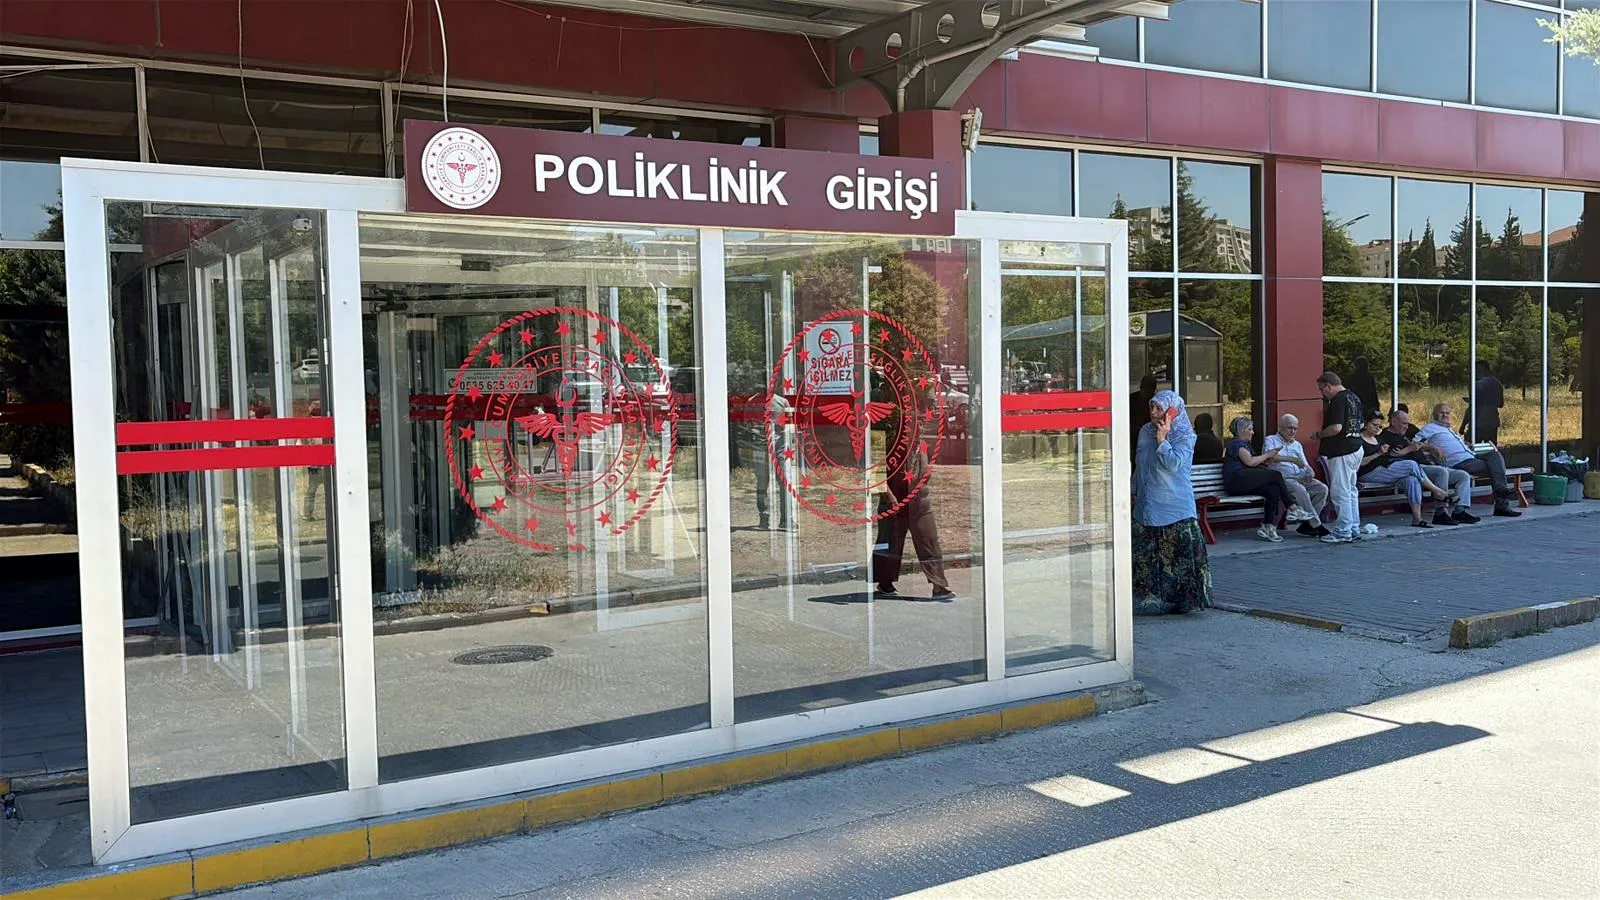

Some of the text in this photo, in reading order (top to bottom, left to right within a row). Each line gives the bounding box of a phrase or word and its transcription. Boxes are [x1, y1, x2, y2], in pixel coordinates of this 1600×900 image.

[534, 152, 939, 220] POLİKLİNİK GİRİŞİ
[870, 352, 907, 391] SAĞLIK
[885, 394, 913, 472] BAKANLIĞI
